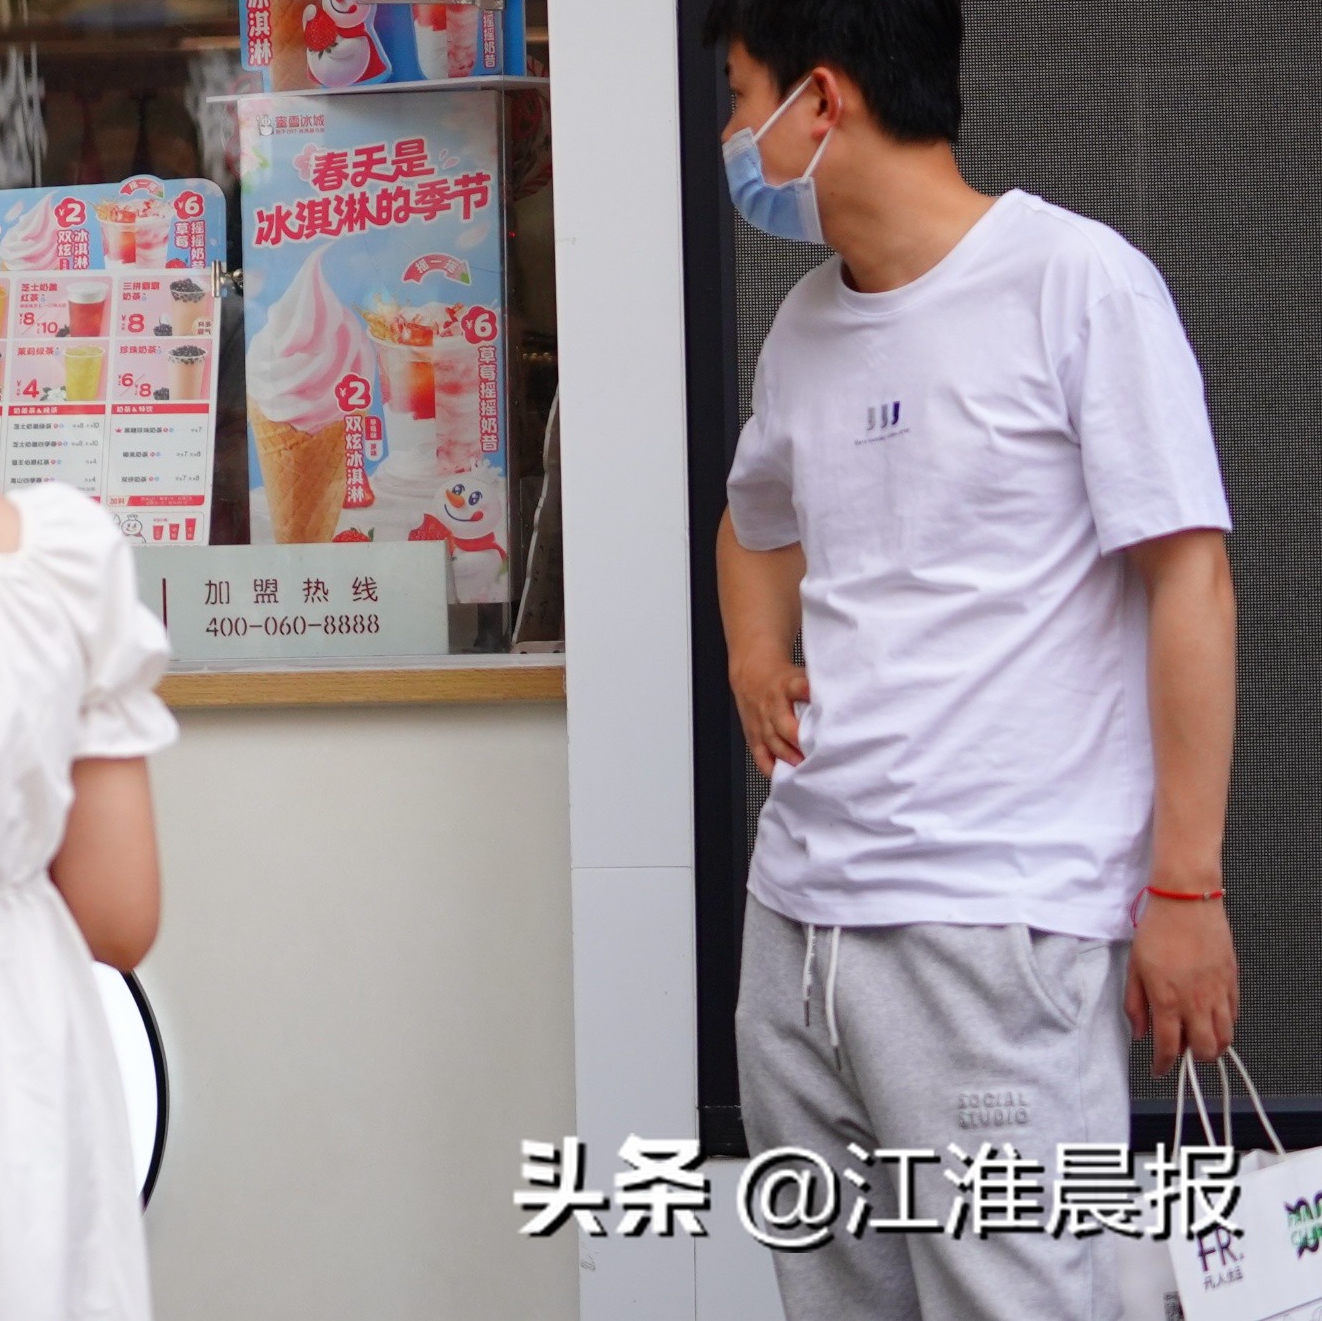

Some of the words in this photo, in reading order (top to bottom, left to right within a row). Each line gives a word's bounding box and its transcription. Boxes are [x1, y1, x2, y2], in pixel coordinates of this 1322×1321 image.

[312, 138, 436, 192] 春天是
[254, 171, 491, 246] 冰淇淋的季节
[479, 345, 498, 452] 草莓摇摇奶昔
[345, 415, 365, 503] 双炫冰淇淋
[204, 576, 380, 606] 加盟热线
[205, 613, 381, 638] 400-060-8888
[957, 1091, 1030, 1110] SOCIAL
[957, 1108, 1029, 1130] STUDIO
